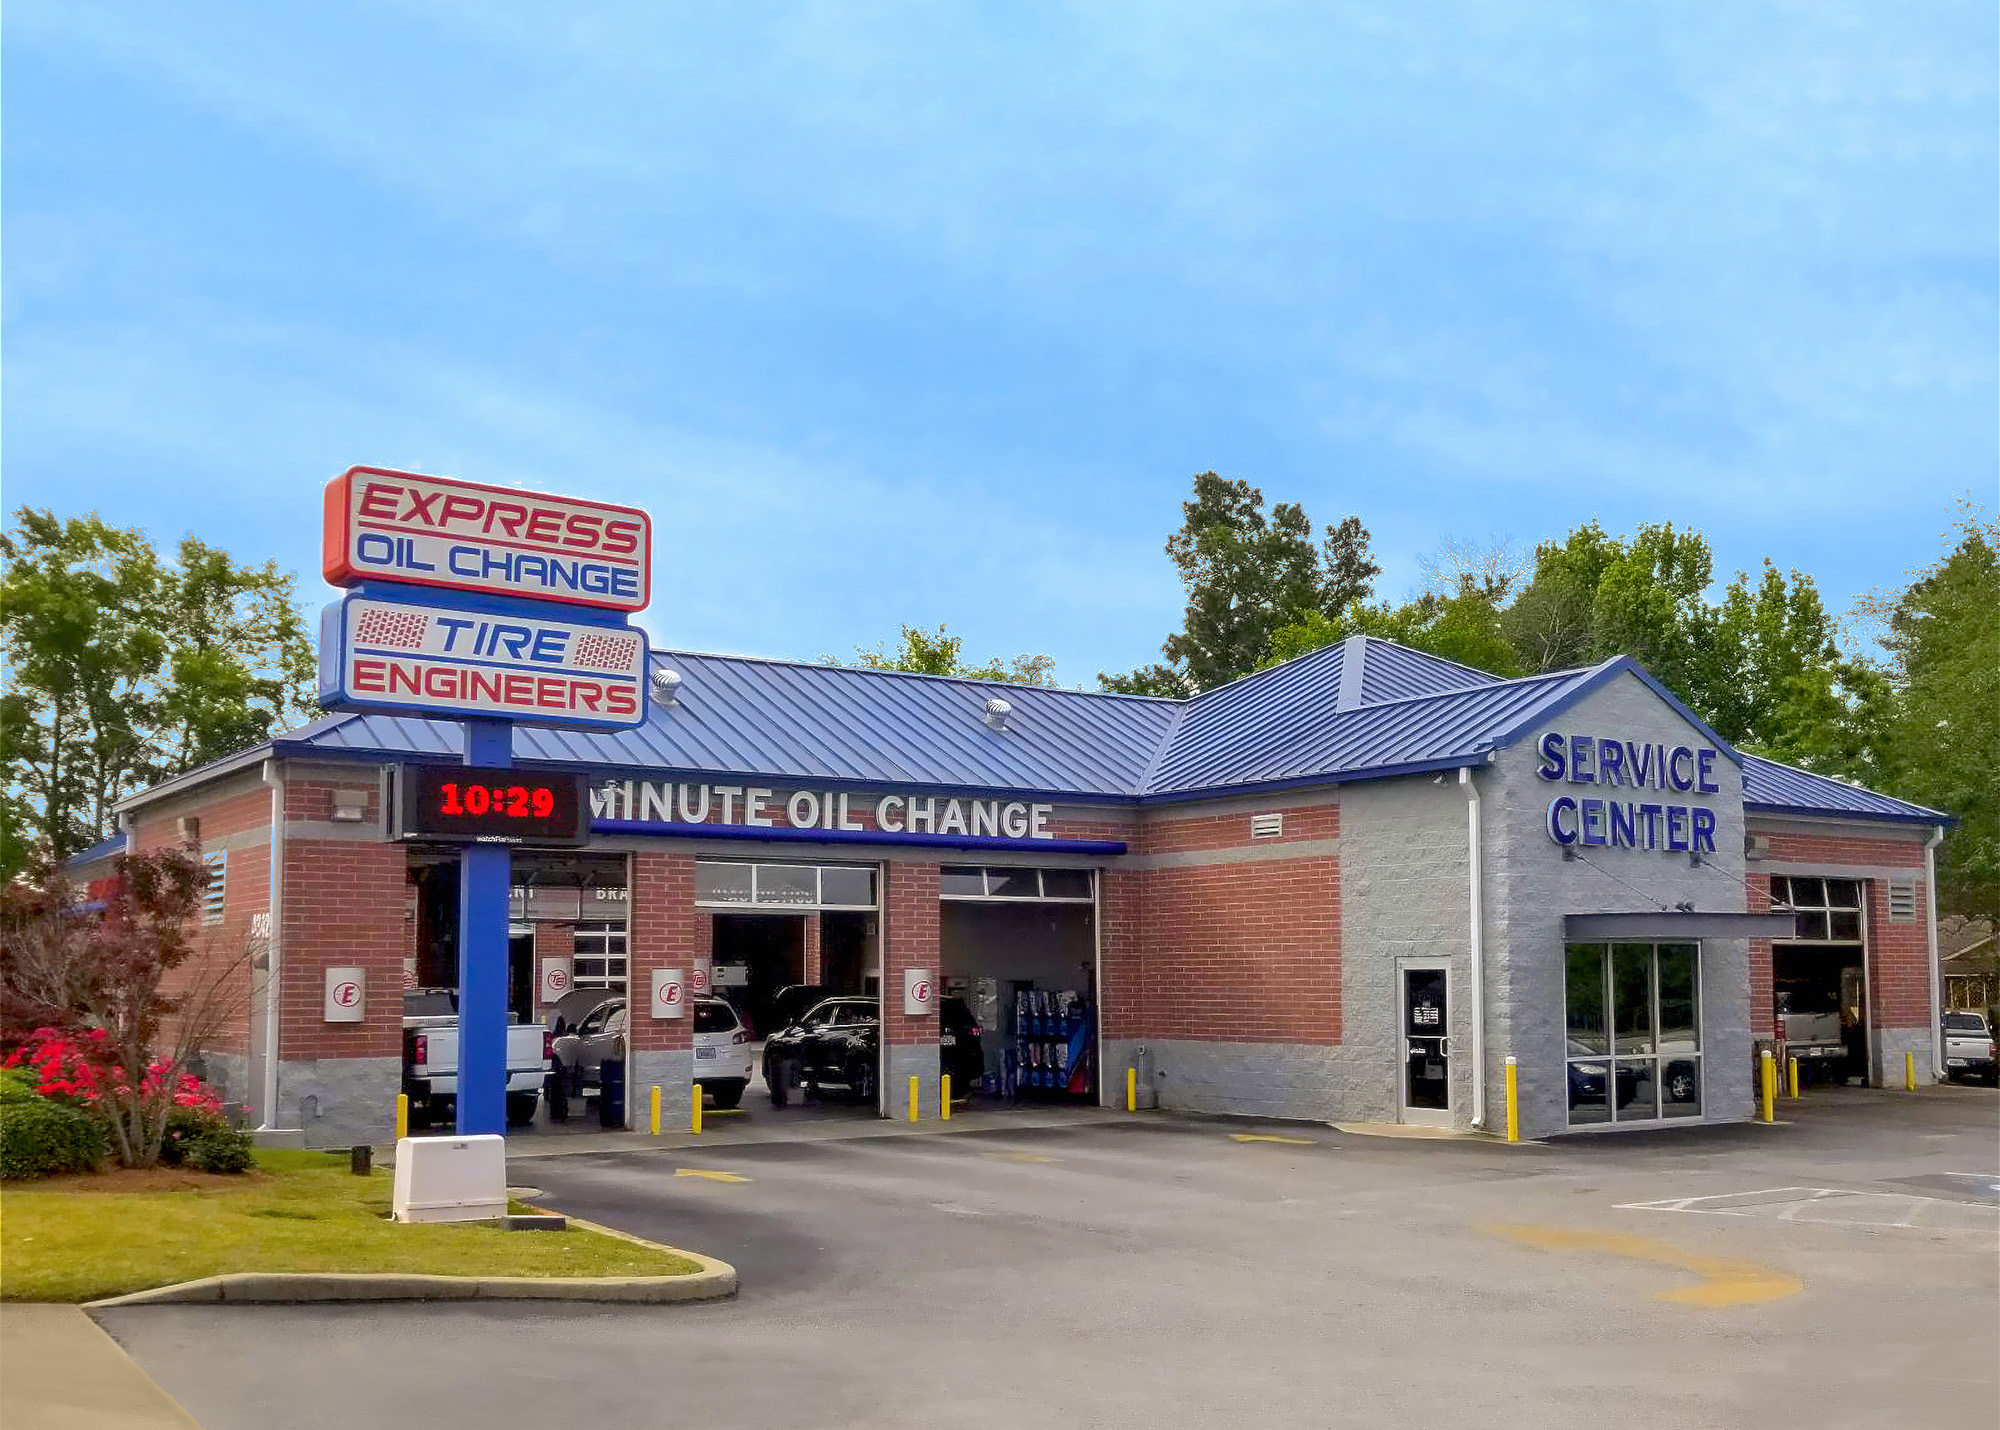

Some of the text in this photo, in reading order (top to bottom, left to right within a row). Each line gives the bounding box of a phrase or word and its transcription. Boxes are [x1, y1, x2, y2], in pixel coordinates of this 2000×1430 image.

[358, 482, 642, 554] EXPRESS
[357, 532, 639, 598] OIL CHANGE
[436, 617, 571, 664] TIRE
[353, 660, 637, 715] ENGINEERS
[1537, 733, 1720, 794] SERVICE
[440, 783, 554, 818] 10:29
[787, 790, 864, 831] OIL
[876, 795, 1053, 839] CHANGE
[1546, 796, 1717, 853] CENTER
